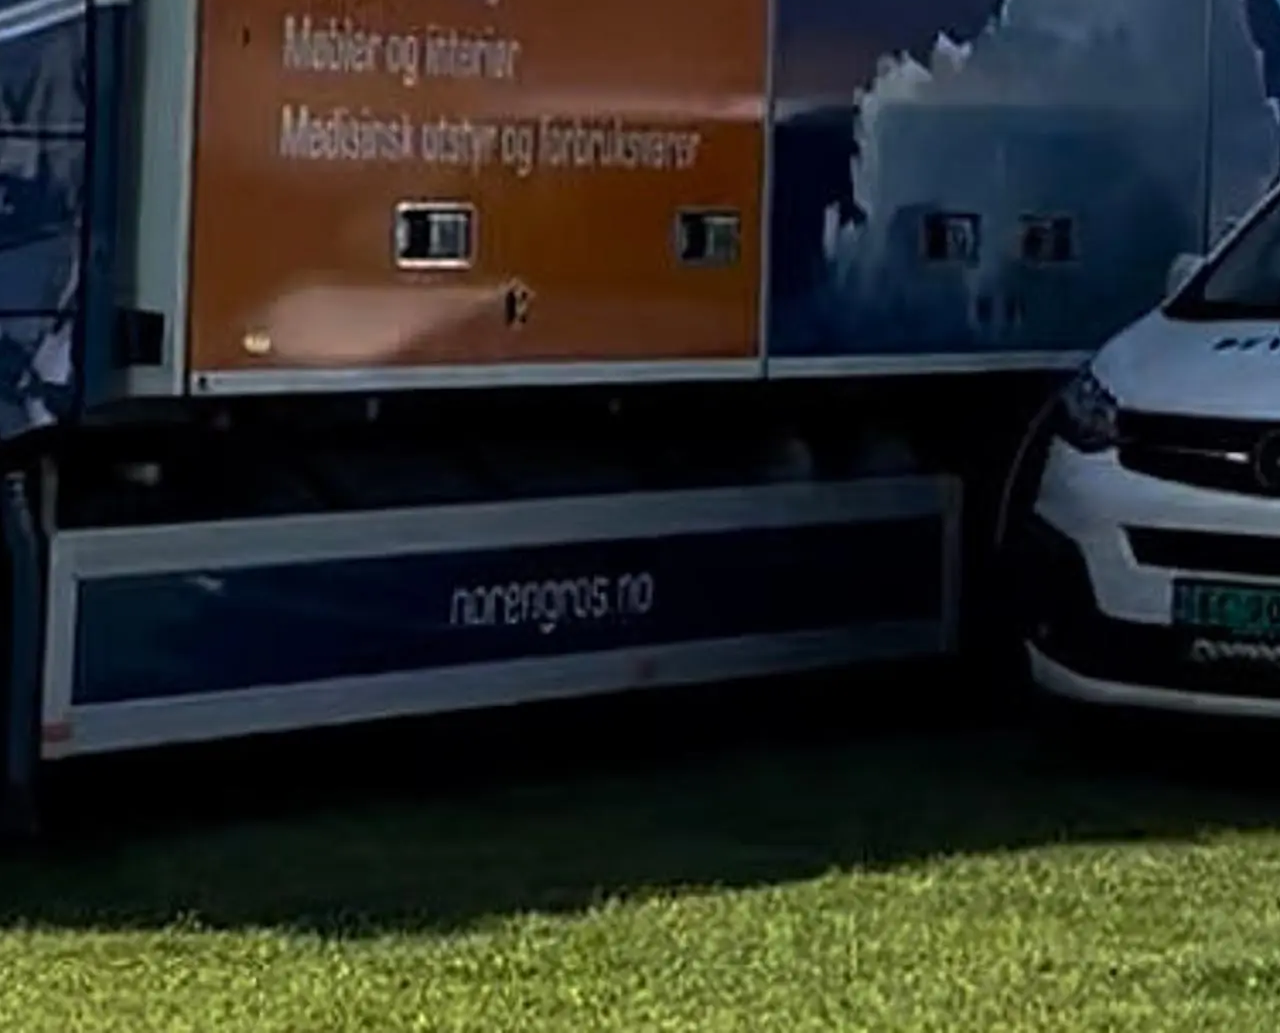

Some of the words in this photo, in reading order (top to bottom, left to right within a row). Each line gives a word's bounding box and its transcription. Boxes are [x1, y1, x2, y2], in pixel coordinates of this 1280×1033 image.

[385, 34, 418, 87] og
[422, 116, 497, 175] utstyr
[501, 122, 534, 176] og
